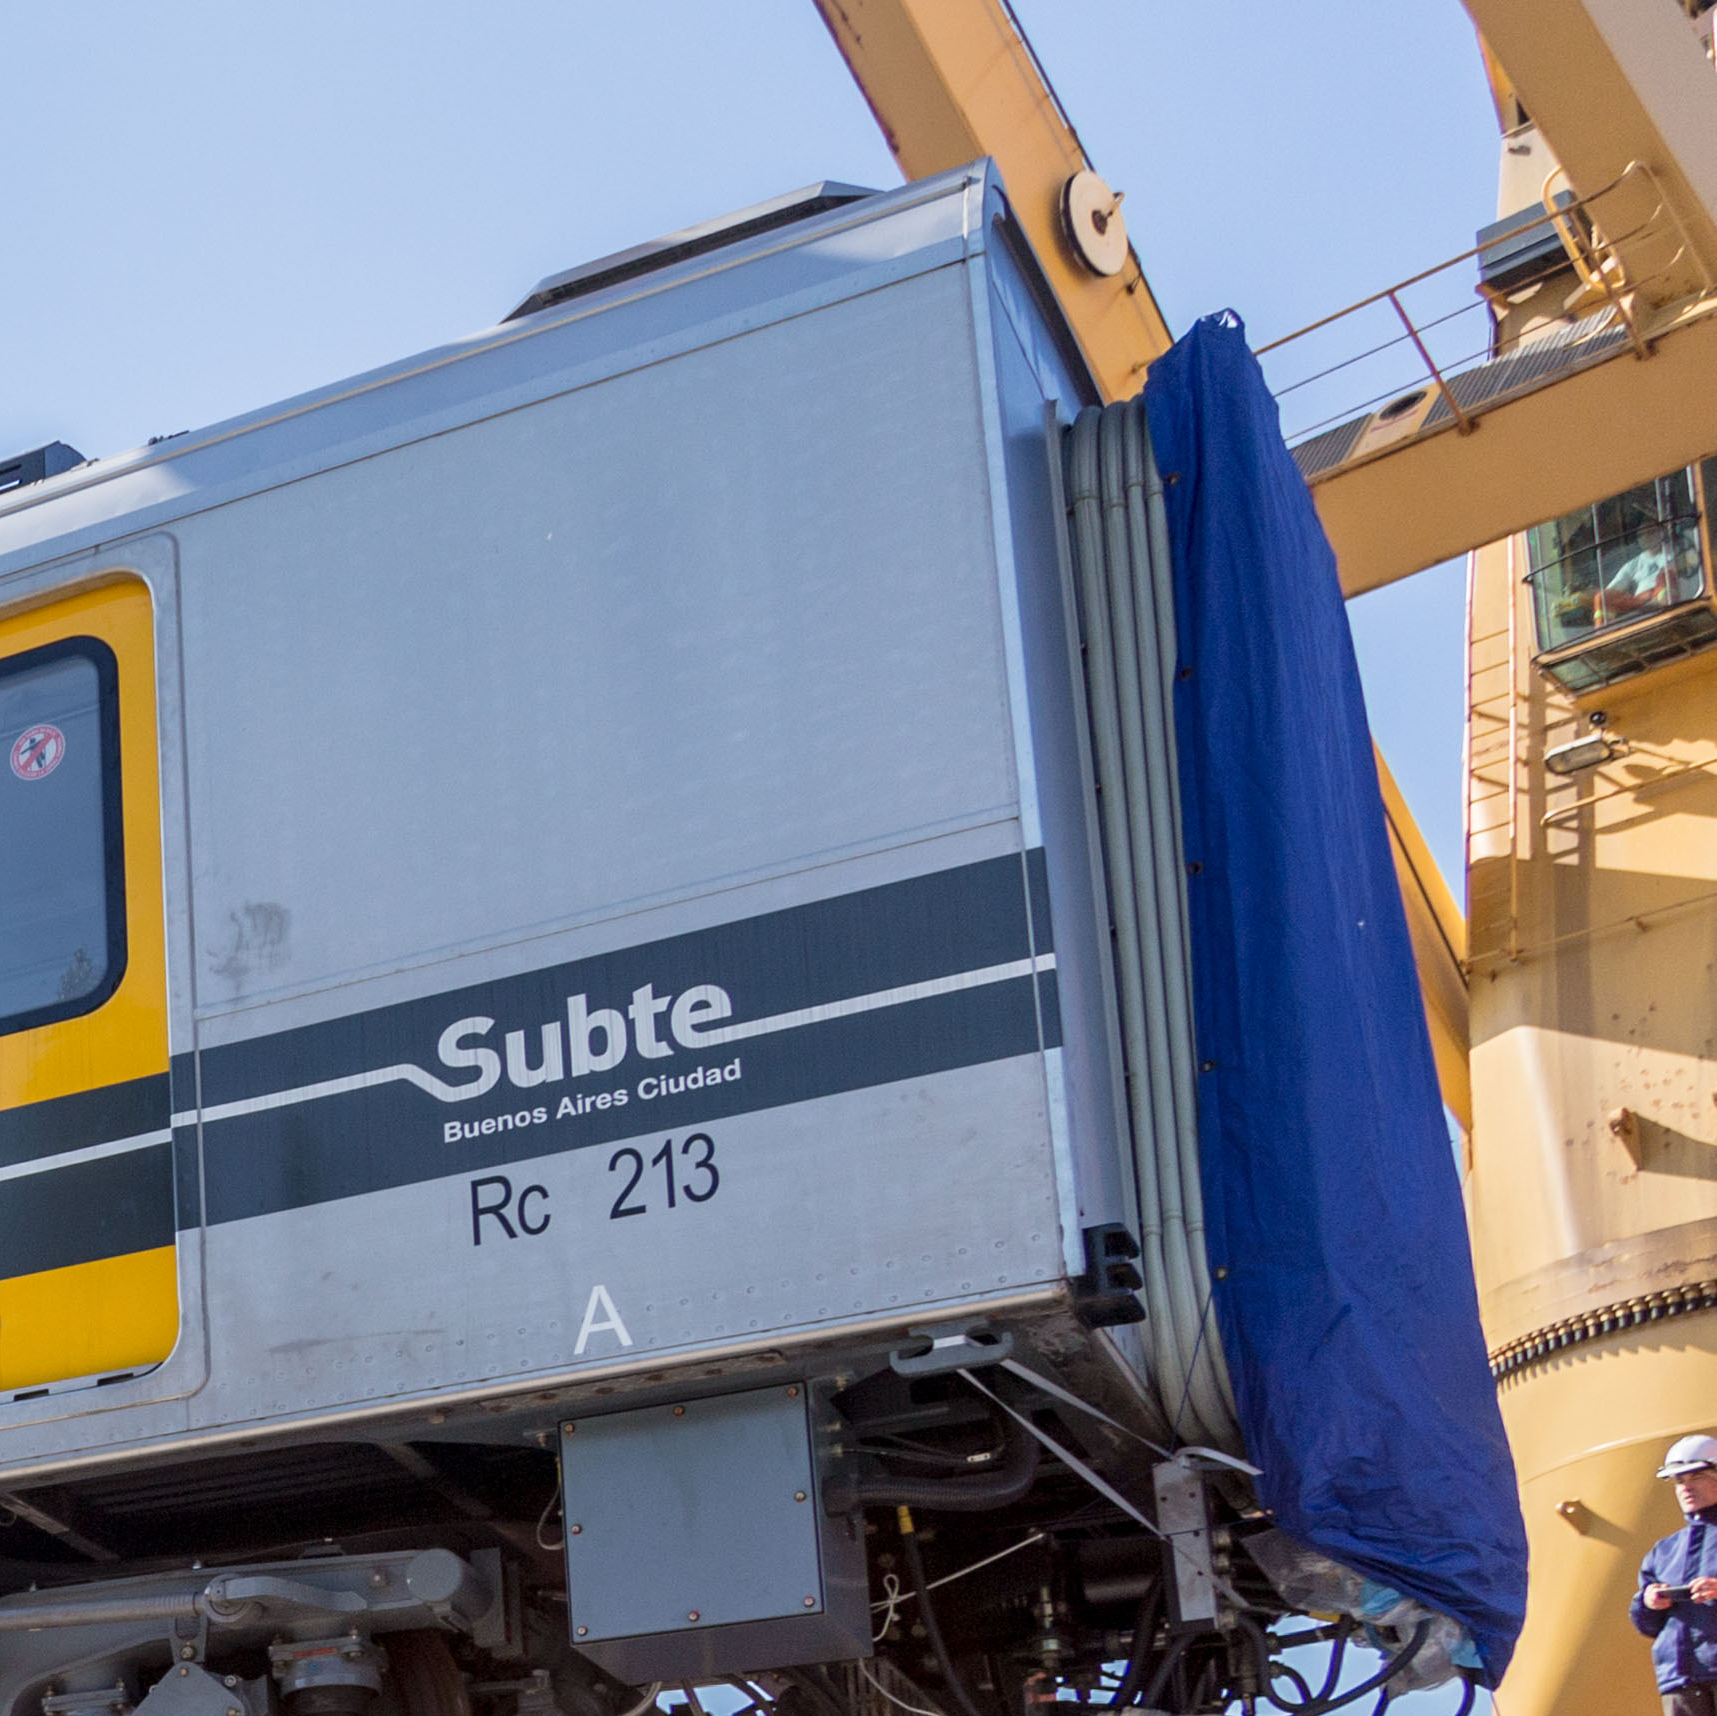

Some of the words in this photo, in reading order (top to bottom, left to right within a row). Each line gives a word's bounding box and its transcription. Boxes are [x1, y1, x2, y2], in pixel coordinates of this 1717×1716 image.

[437, 982, 733, 1103] Subte
[443, 1104, 547, 1143] Buenos
[556, 1085, 630, 1120] Aires
[637, 1058, 743, 1104] Ciudad
[469, 1175, 552, 1246] Rc
[608, 1133, 721, 1220] 213
[573, 1285, 633, 1354] A
